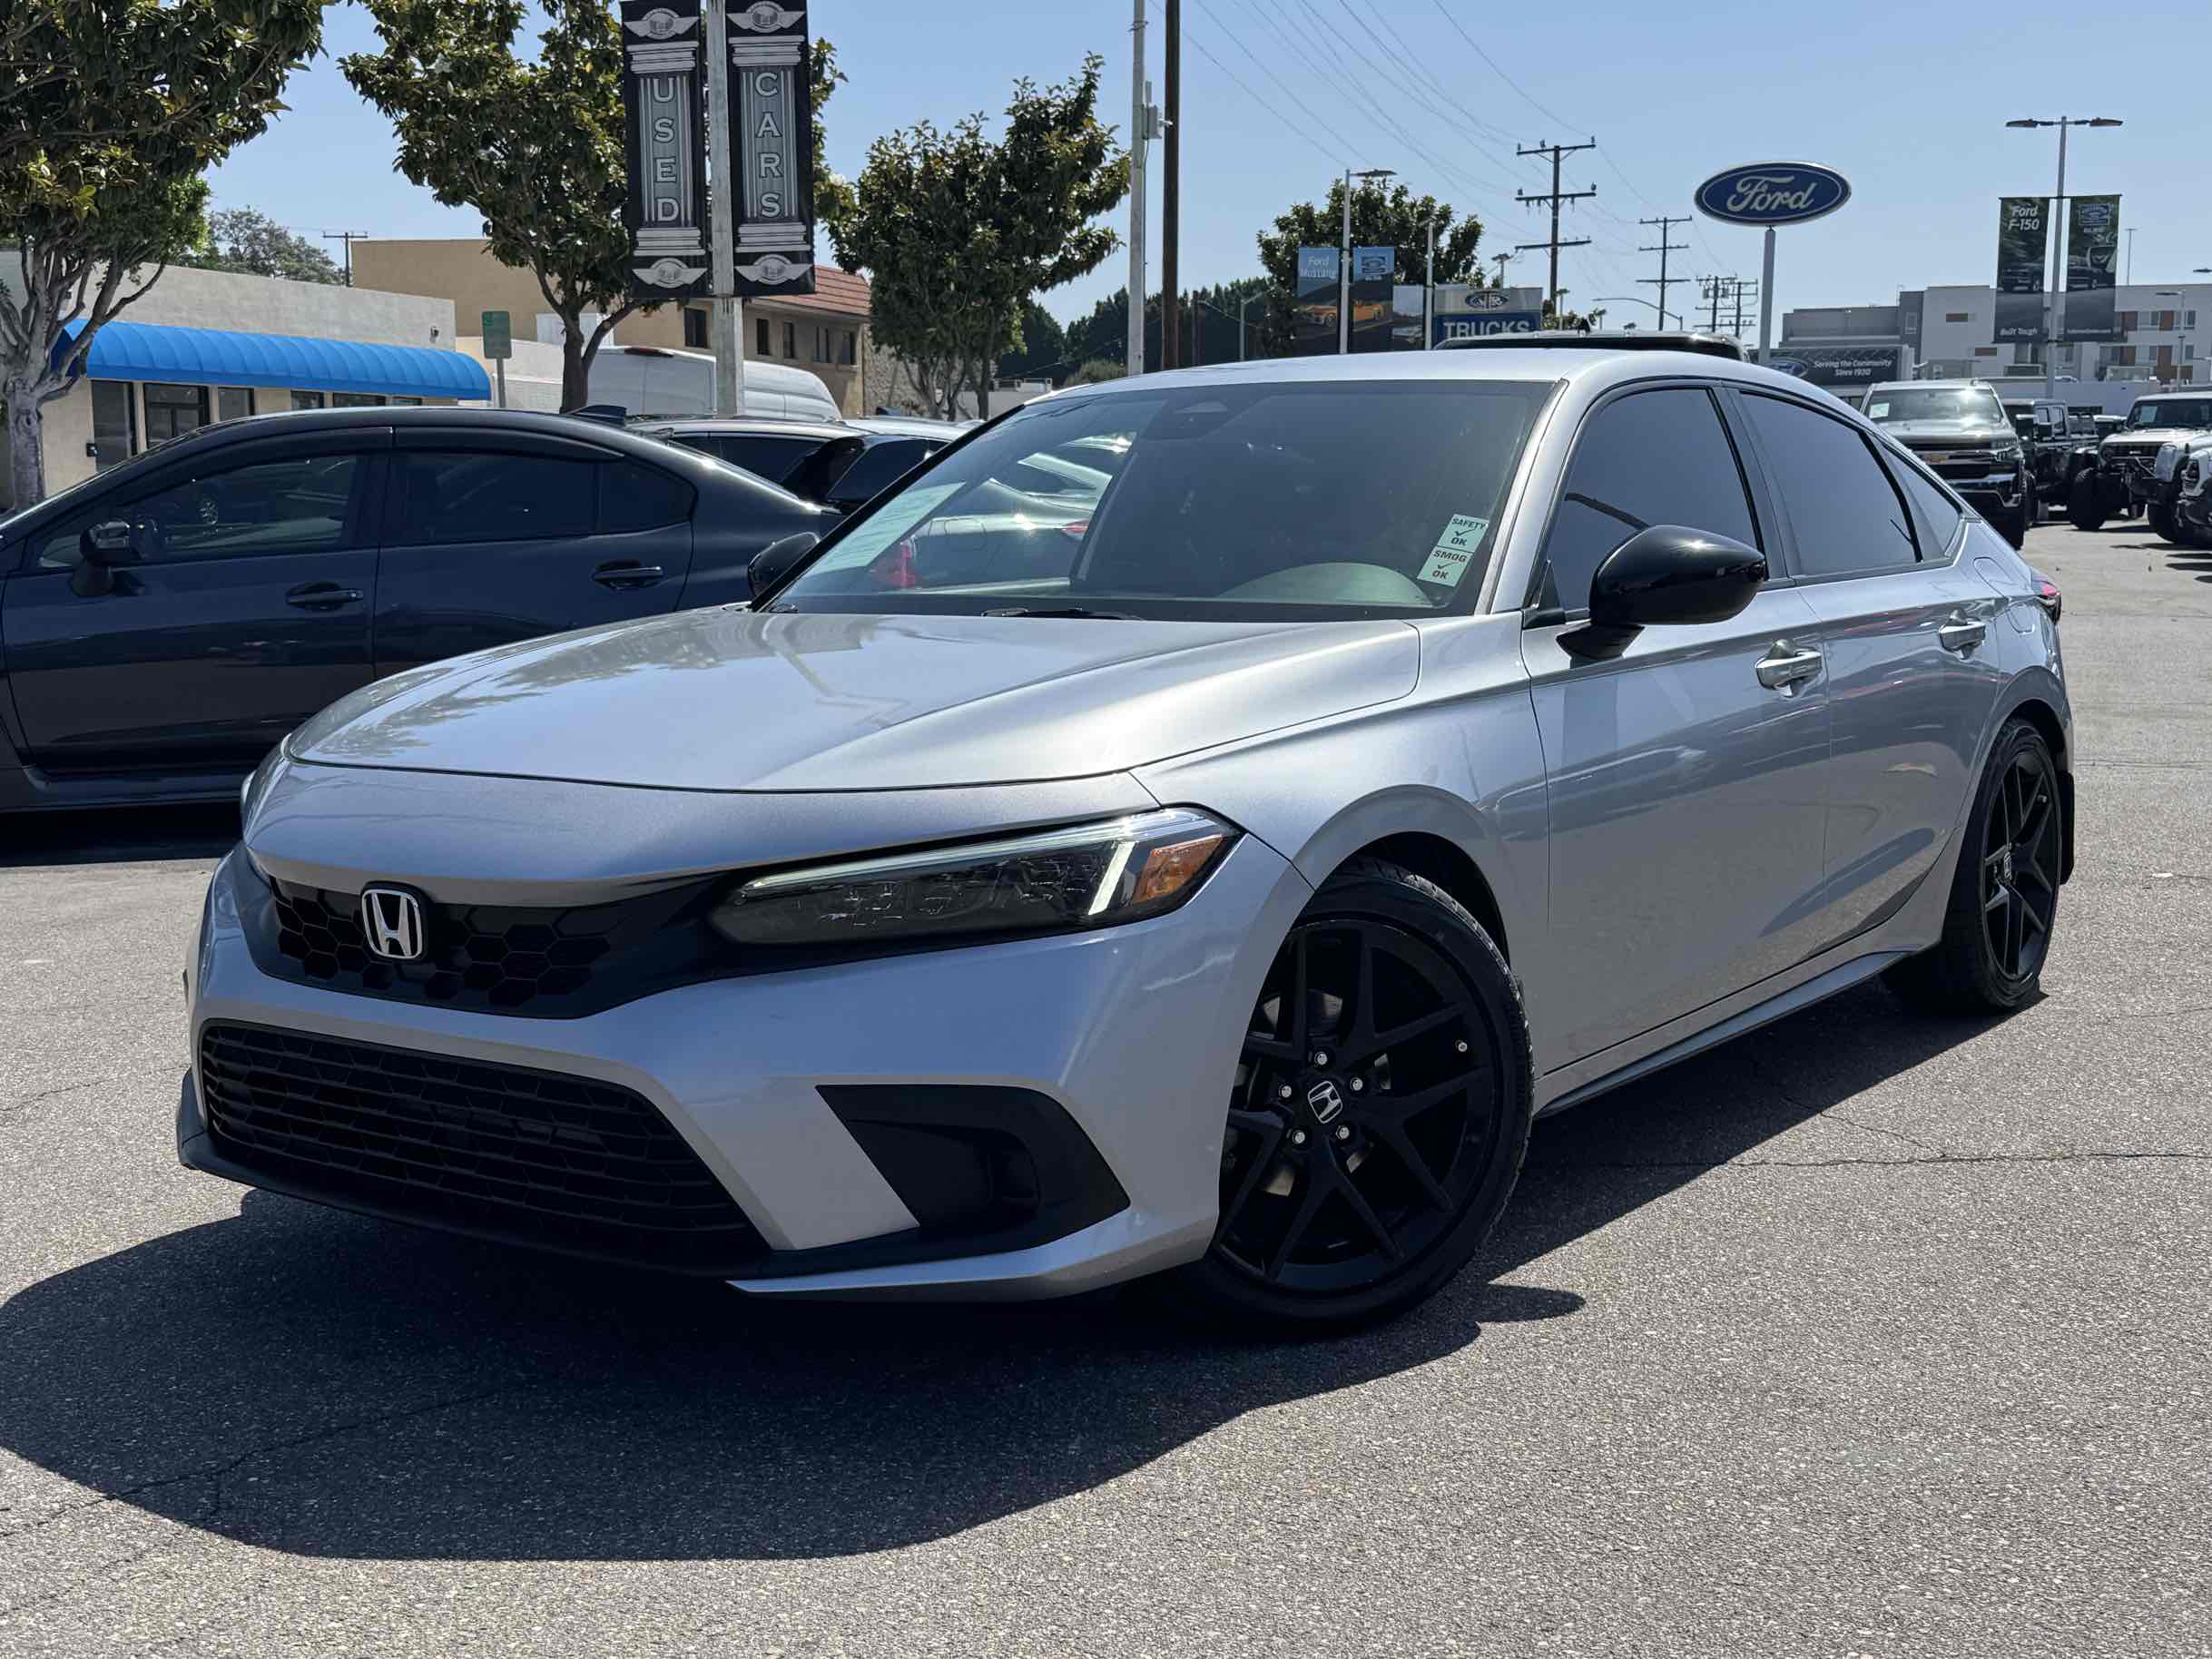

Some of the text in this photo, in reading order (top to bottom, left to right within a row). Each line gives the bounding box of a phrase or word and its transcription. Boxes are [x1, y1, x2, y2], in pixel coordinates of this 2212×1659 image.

[653, 77, 680, 222] USED
[755, 72, 782, 219] CARS
[1726, 175, 1817, 212] Ford
[2010, 203, 2039, 217] Ford
[2008, 218, 2040, 231] F-150
[1443, 320, 1530, 339] TRUCKS
[1452, 517, 1487, 530] SAFETY
[1450, 537, 1468, 546] OK
[1434, 550, 1468, 563] SMOG
[1432, 570, 1450, 579] OK
